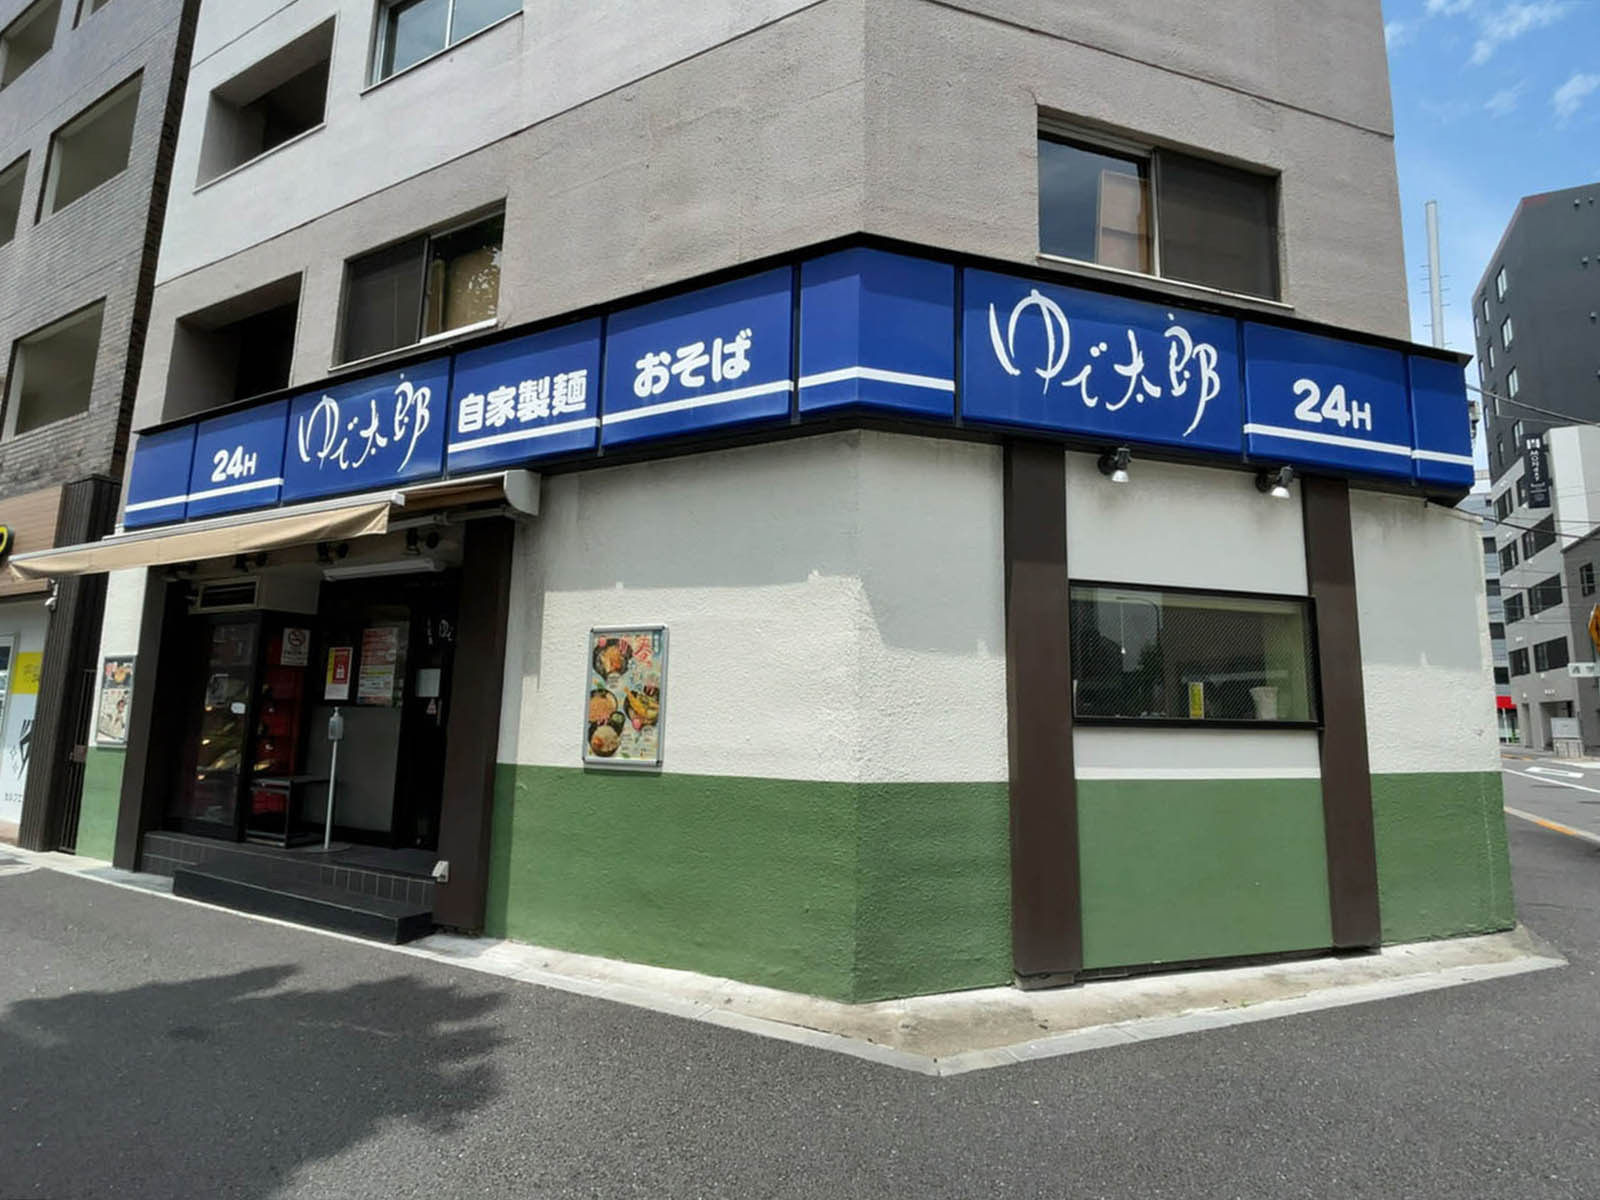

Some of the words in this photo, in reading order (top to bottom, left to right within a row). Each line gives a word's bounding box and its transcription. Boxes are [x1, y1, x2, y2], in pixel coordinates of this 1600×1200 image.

[633, 328, 752, 397] おそば
[989, 289, 1221, 437] ゆで太郎
[298, 374, 432, 472] ゆで太郎
[457, 369, 588, 433] 自家製麺
[1293, 379, 1372, 431] 24H
[211, 445, 257, 482] 24H
